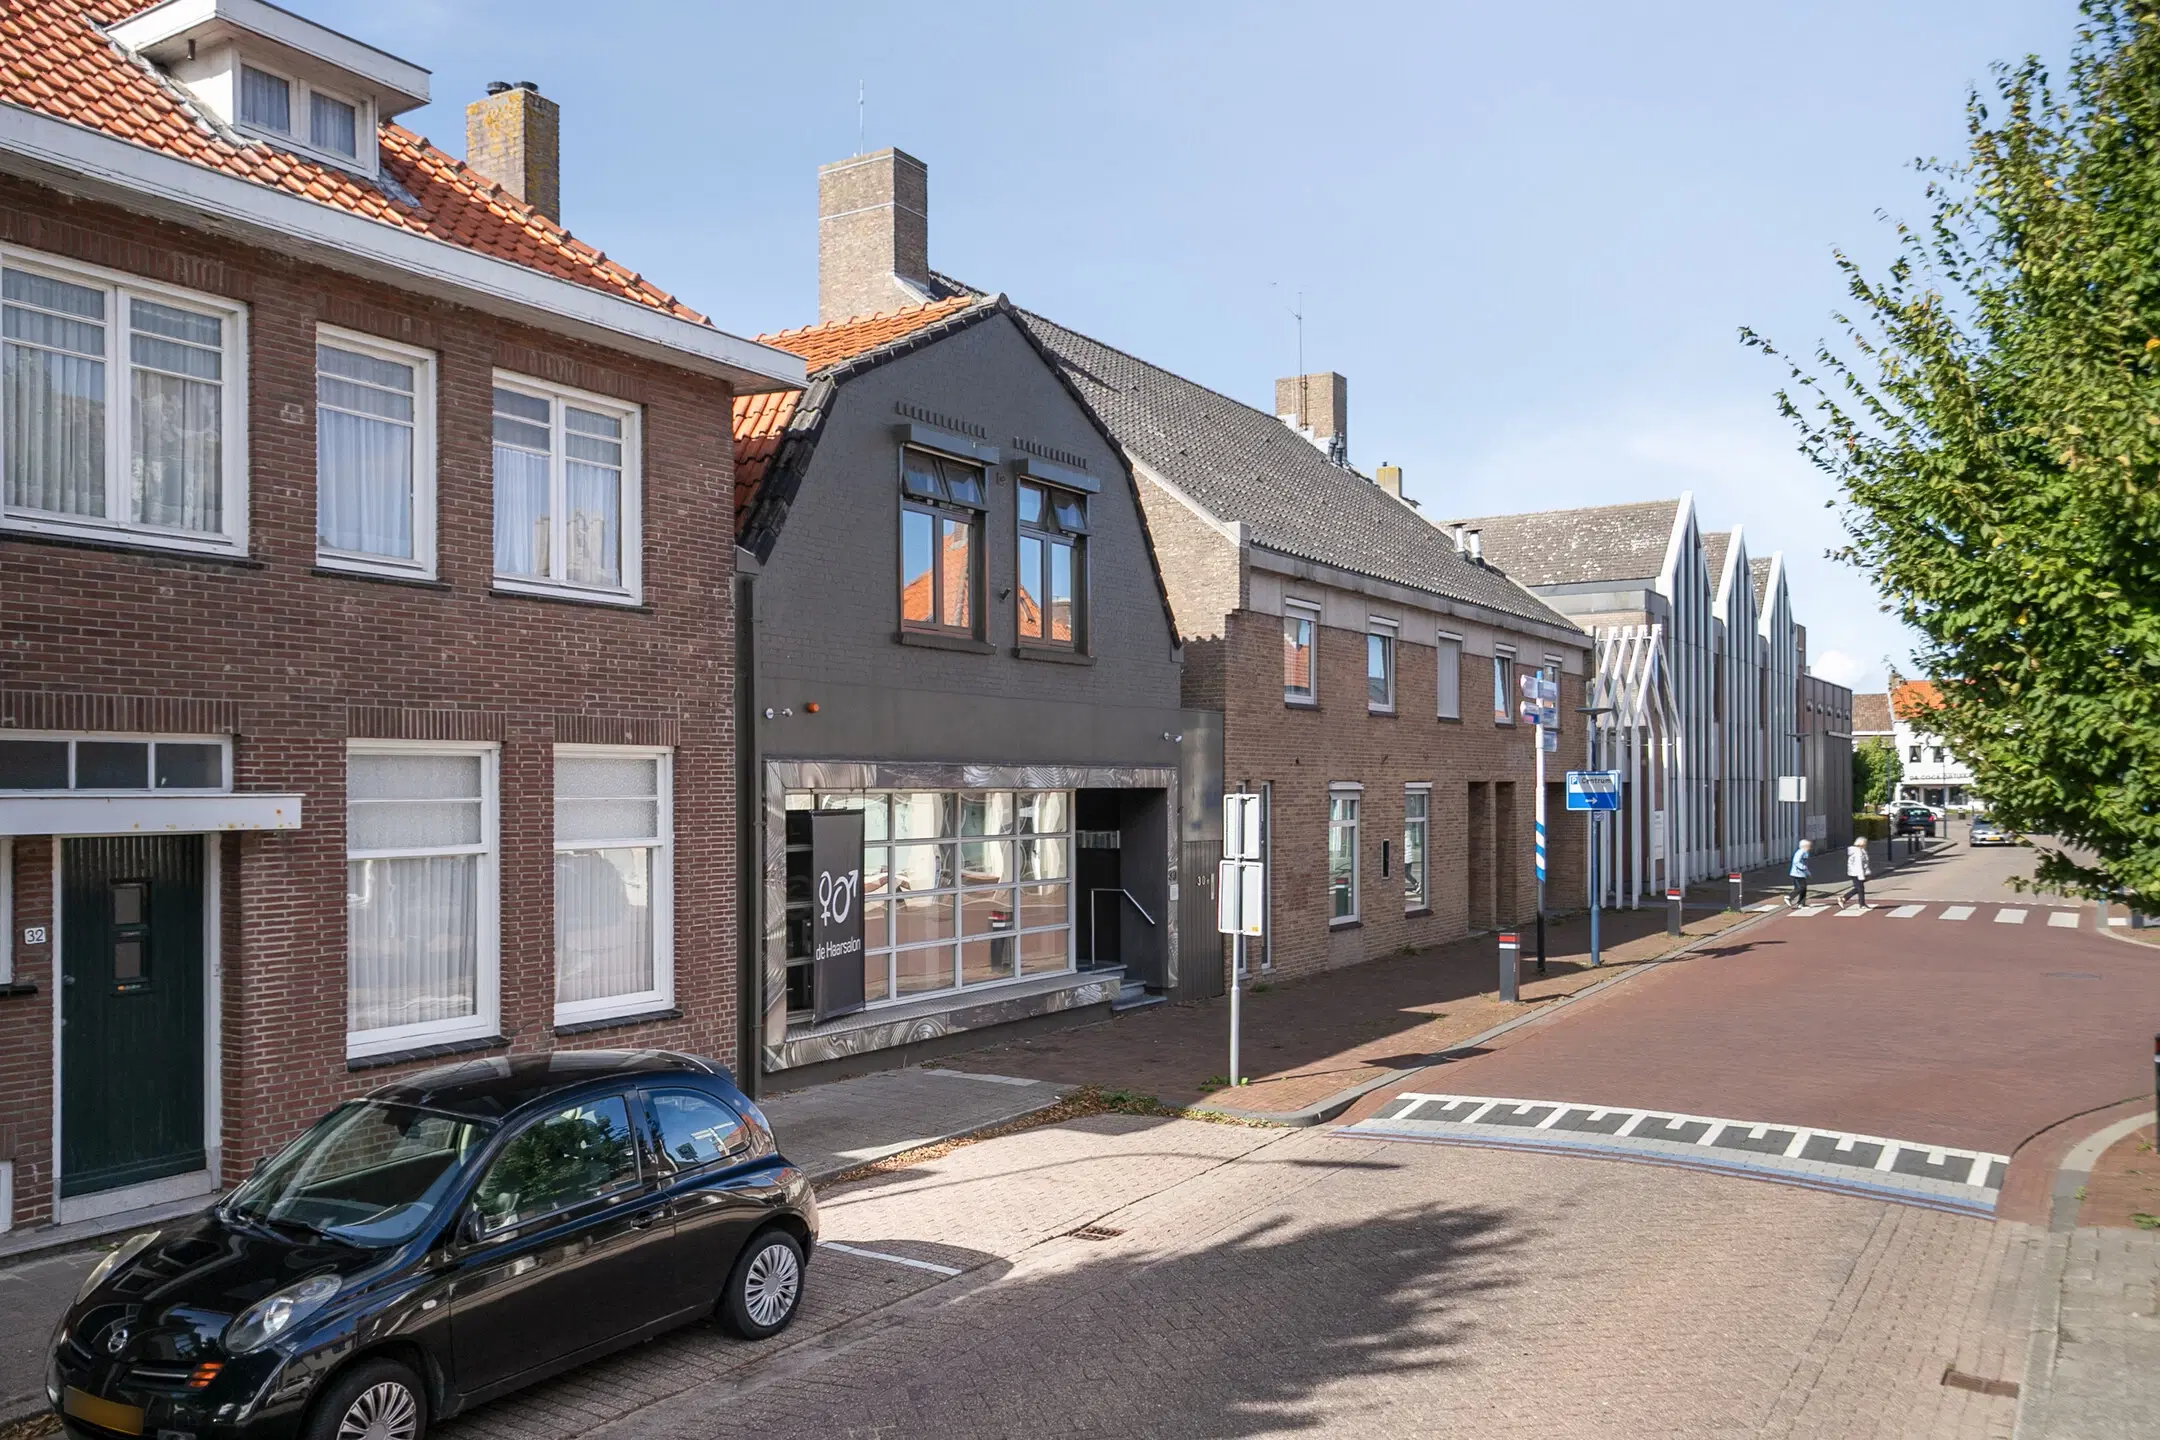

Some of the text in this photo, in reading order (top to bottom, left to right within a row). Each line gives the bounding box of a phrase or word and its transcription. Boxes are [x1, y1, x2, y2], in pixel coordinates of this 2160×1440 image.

[26, 929, 44, 942] 32
[815, 936, 861, 961] de Haarsalon
